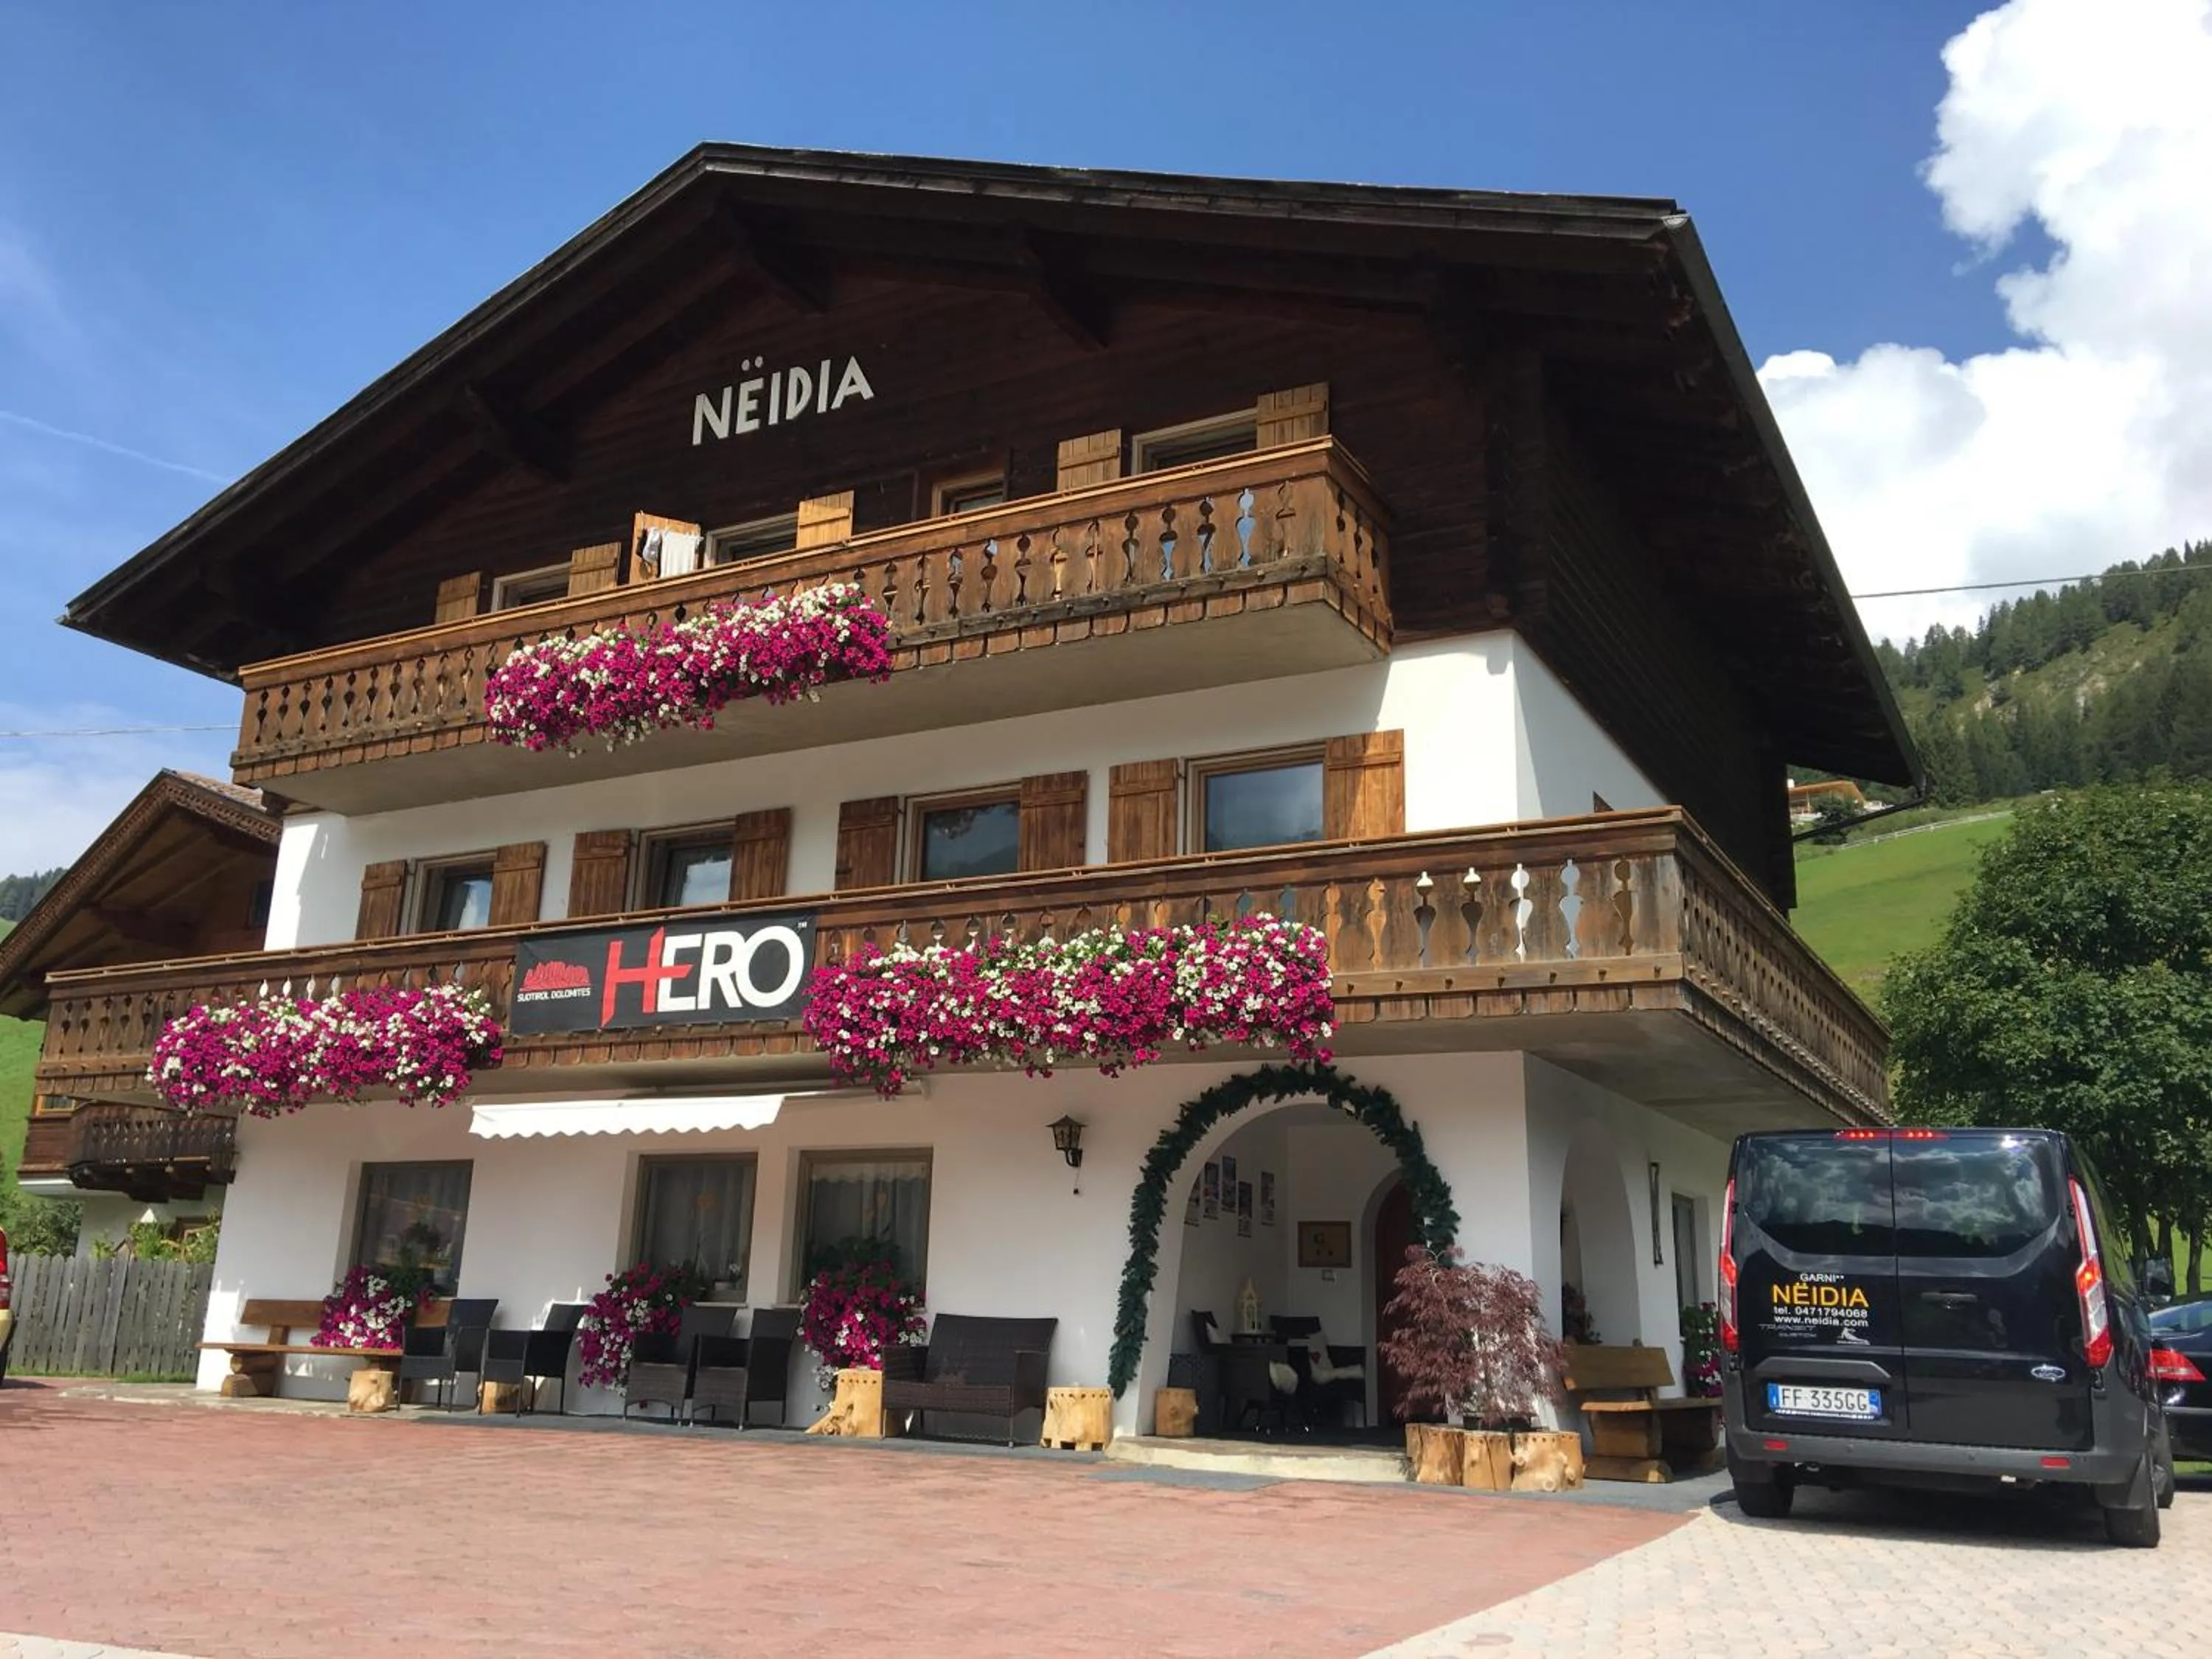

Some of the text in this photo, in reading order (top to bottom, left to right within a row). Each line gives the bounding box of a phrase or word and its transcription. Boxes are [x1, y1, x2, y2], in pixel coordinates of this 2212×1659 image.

[692, 355, 874, 445] NËIDIA
[601, 925, 805, 1027] HERO
[551, 987, 591, 999] DOLOMITES
[1773, 1282, 1869, 1307] NËIDIA
[1773, 1306, 1868, 1318] tel. 0471794068
[1774, 1316, 1868, 1327] www.neidia.com
[1781, 1388, 1868, 1411] FF 335GG
